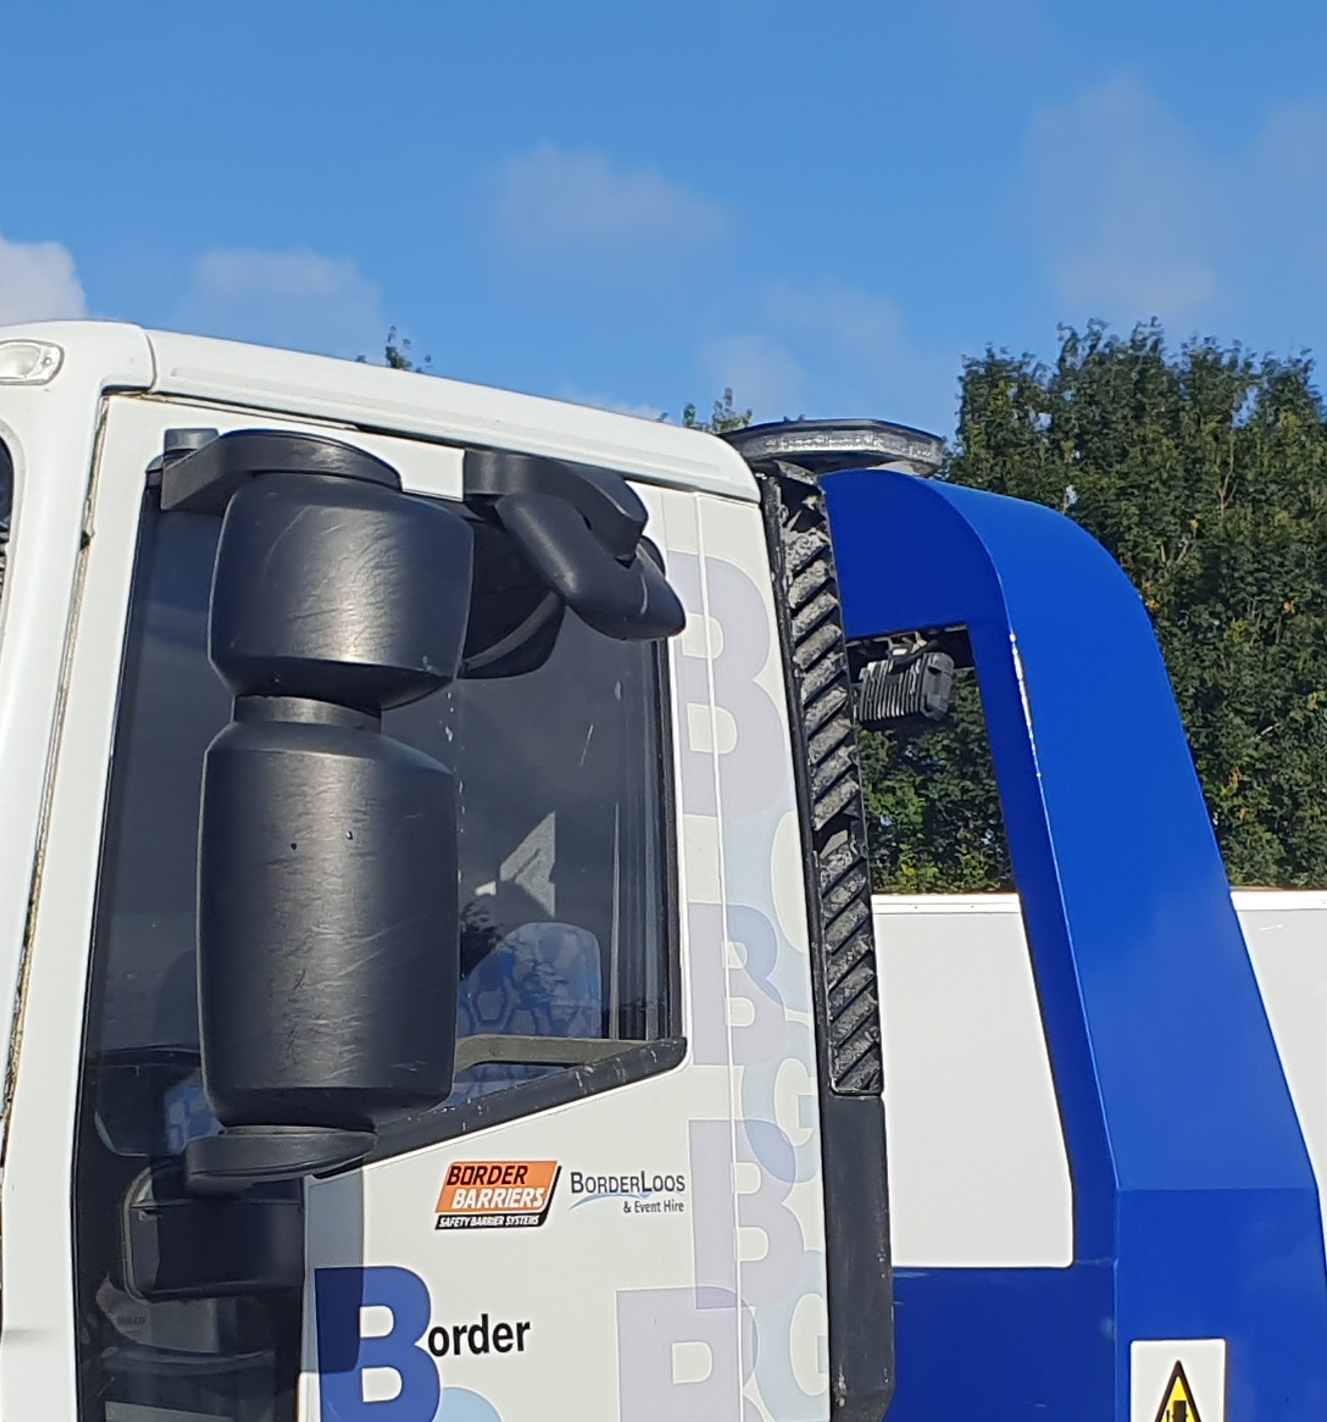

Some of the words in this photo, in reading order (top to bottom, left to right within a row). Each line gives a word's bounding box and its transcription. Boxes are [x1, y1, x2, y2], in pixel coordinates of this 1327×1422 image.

[447, 1165, 528, 1186] BORDER
[451, 1187, 546, 1210] BARRIERS
[623, 1201, 632, 1213] &
[634, 1200, 661, 1214] Event
[663, 1199, 684, 1213] Hire
[438, 1215, 470, 1228] SAFETY
[470, 1215, 505, 1227] BARRIER
[505, 1214, 541, 1227] SYSTEMS
